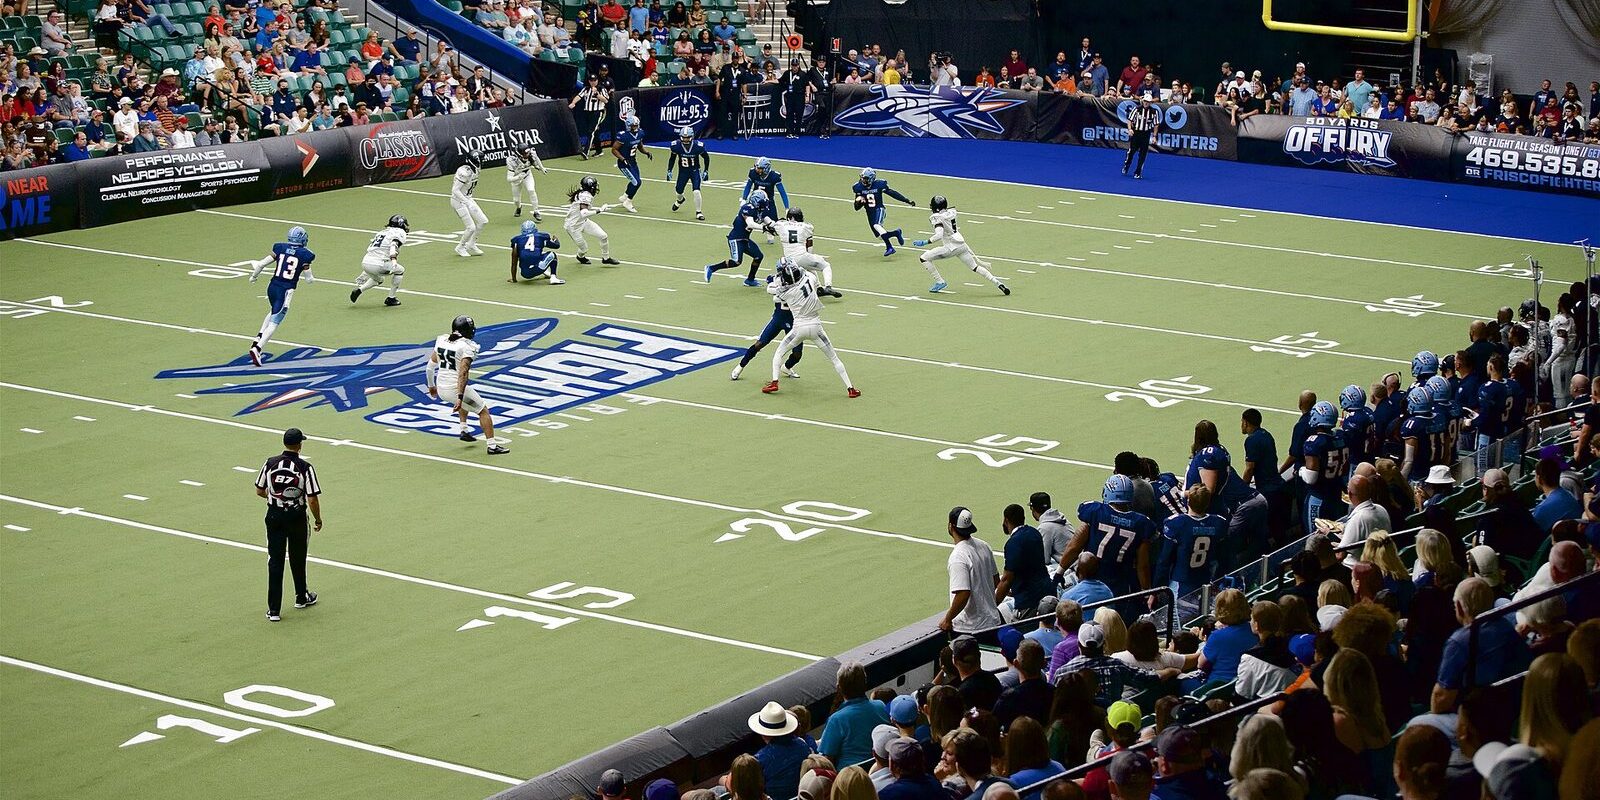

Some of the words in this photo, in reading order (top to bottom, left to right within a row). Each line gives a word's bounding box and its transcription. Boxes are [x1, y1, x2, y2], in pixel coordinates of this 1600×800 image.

[660, 105, 680, 121] KHYI
[689, 104, 709, 119] 95.3
[1326, 118, 1379, 130] YARDS
[360, 134, 430, 169] CLASSIC
[455, 132, 508, 156] NORTH
[508, 129, 544, 148] STAR
[1285, 126, 1319, 152] OF
[1322, 128, 1390, 158] FURY
[1469, 135, 1488, 146] TAKE
[1488, 137, 1514, 149] FLIGHT
[1515, 140, 1529, 151] ALL
[1529, 142, 1560, 155] SEASON
[125, 150, 226, 169] PERFORMANCE
[681, 157, 695, 168] 81
[1465, 147, 1600, 178] 469.535.8
[112, 160, 244, 185] NEUROPSYCHOLOGY
[200, 179, 223, 188] SPORTS
[223, 175, 259, 186] PSYCHOLOGY
[1466, 168, 1480, 176] OR
[7, 175, 49, 195] NEAR
[101, 192, 128, 201] CLINICAL
[128, 184, 181, 197] NEUROPSYCHOLOGY
[275, 185, 302, 195] RETURN
[305, 182, 315, 190] TO
[316, 178, 343, 189] HEALTH
[142, 195, 176, 204] CONCUSSION
[177, 189, 217, 200] MANAGEMENT
[866, 193, 876, 208] 9
[10, 196, 51, 228] ME
[524, 235, 535, 251] 4
[788, 229, 798, 244] 6
[275, 253, 299, 280] 13
[1365, 297, 1446, 317] 10
[1250, 334, 1341, 358] 15
[437, 347, 457, 370] 35
[1105, 378, 1213, 409] 20
[936, 433, 1061, 468] 25
[275, 475, 294, 484] 87
[729, 500, 873, 542] 20
[1096, 522, 1137, 563] 77
[1189, 536, 1211, 568] 8
[483, 581, 636, 630] 15
[157, 684, 337, 744] 10
